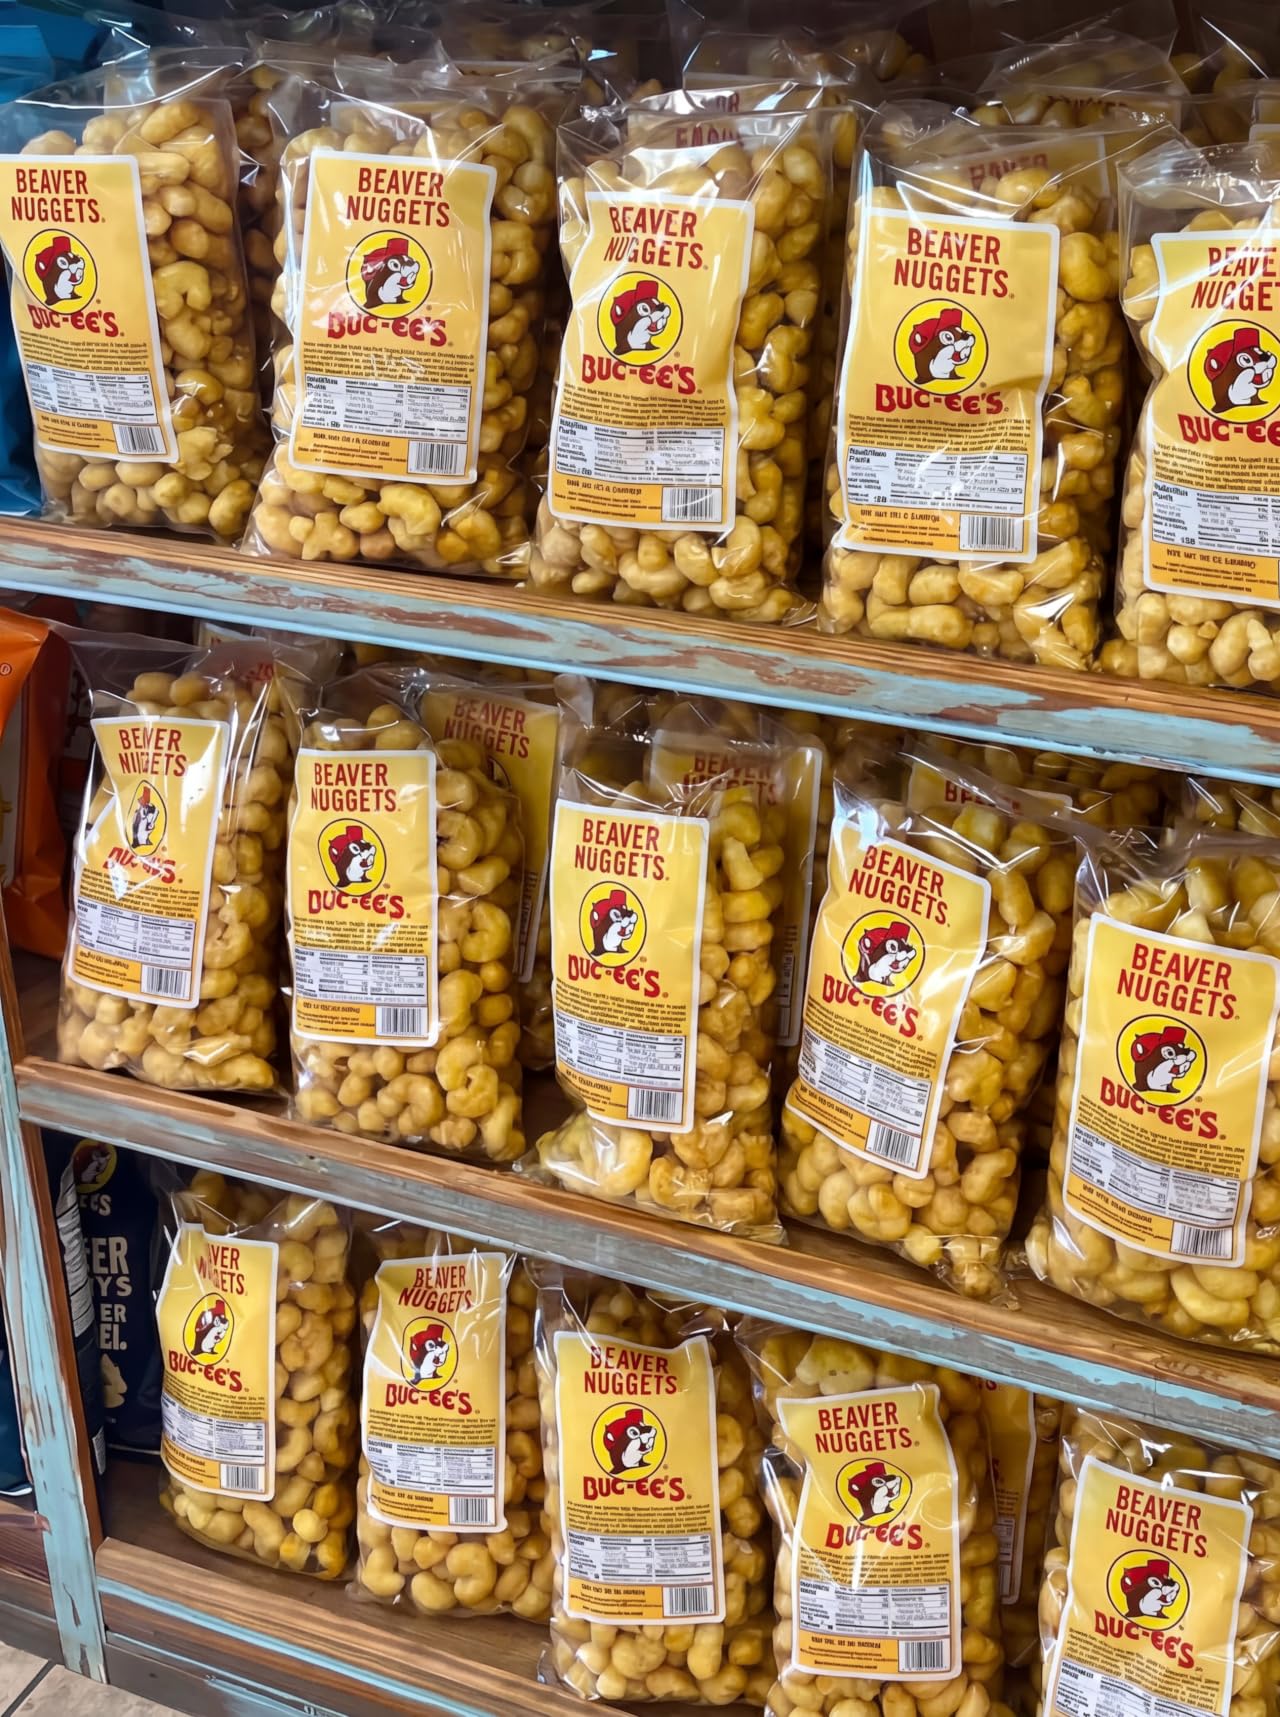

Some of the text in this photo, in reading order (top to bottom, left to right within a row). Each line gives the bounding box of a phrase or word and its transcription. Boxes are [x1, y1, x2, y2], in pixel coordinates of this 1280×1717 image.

[16, 169, 88, 194] BEAVER
[359, 168, 443, 197] BEAVER
[12, 197, 100, 223] NUGGETS
[348, 196, 449, 227] NUGGETS
[609, 207, 696, 237] BEAVER
[605, 238, 703, 269] NUGGETS
[908, 228, 1000, 265] BEAVER
[895, 259, 1008, 298] NUGGETS
[875, 384, 1003, 416] BUC-EE'S
[454, 696, 527, 734] BEAVER
[315, 763, 387, 786] BEAVER
[312, 789, 395, 812] NUGGETS
[583, 819, 659, 851] BEAVER
[576, 846, 664, 880] NUGGETS
[863, 846, 944, 897] BEAVER
[849, 869, 947, 925] NUGGETS
[1132, 943, 1232, 990] BEAVER
[822, 974, 919, 1038] BUC-EE'S
[1117, 969, 1237, 1020] NUGGETS
[1100, 1077, 1218, 1139] BUC-EE'S
[414, 1265, 467, 1290] BEAVER
[399, 1287, 472, 1314] NUGGETS
[169, 1350, 242, 1392] BUC-EE'S
[590, 1346, 669, 1374] BEAVER
[584, 1371, 678, 1396] NUGGETS
[386, 1384, 472, 1415] BUC-EE'S
[818, 1402, 898, 1430] BEAVER
[816, 1427, 912, 1453] NUGGETS
[583, 1476, 685, 1502] BUC-EE'S
[1116, 1485, 1201, 1530] BEAVER
[1106, 1509, 1206, 1558] NUGGETS
[1095, 1611, 1194, 1669] BUC-EE'S
